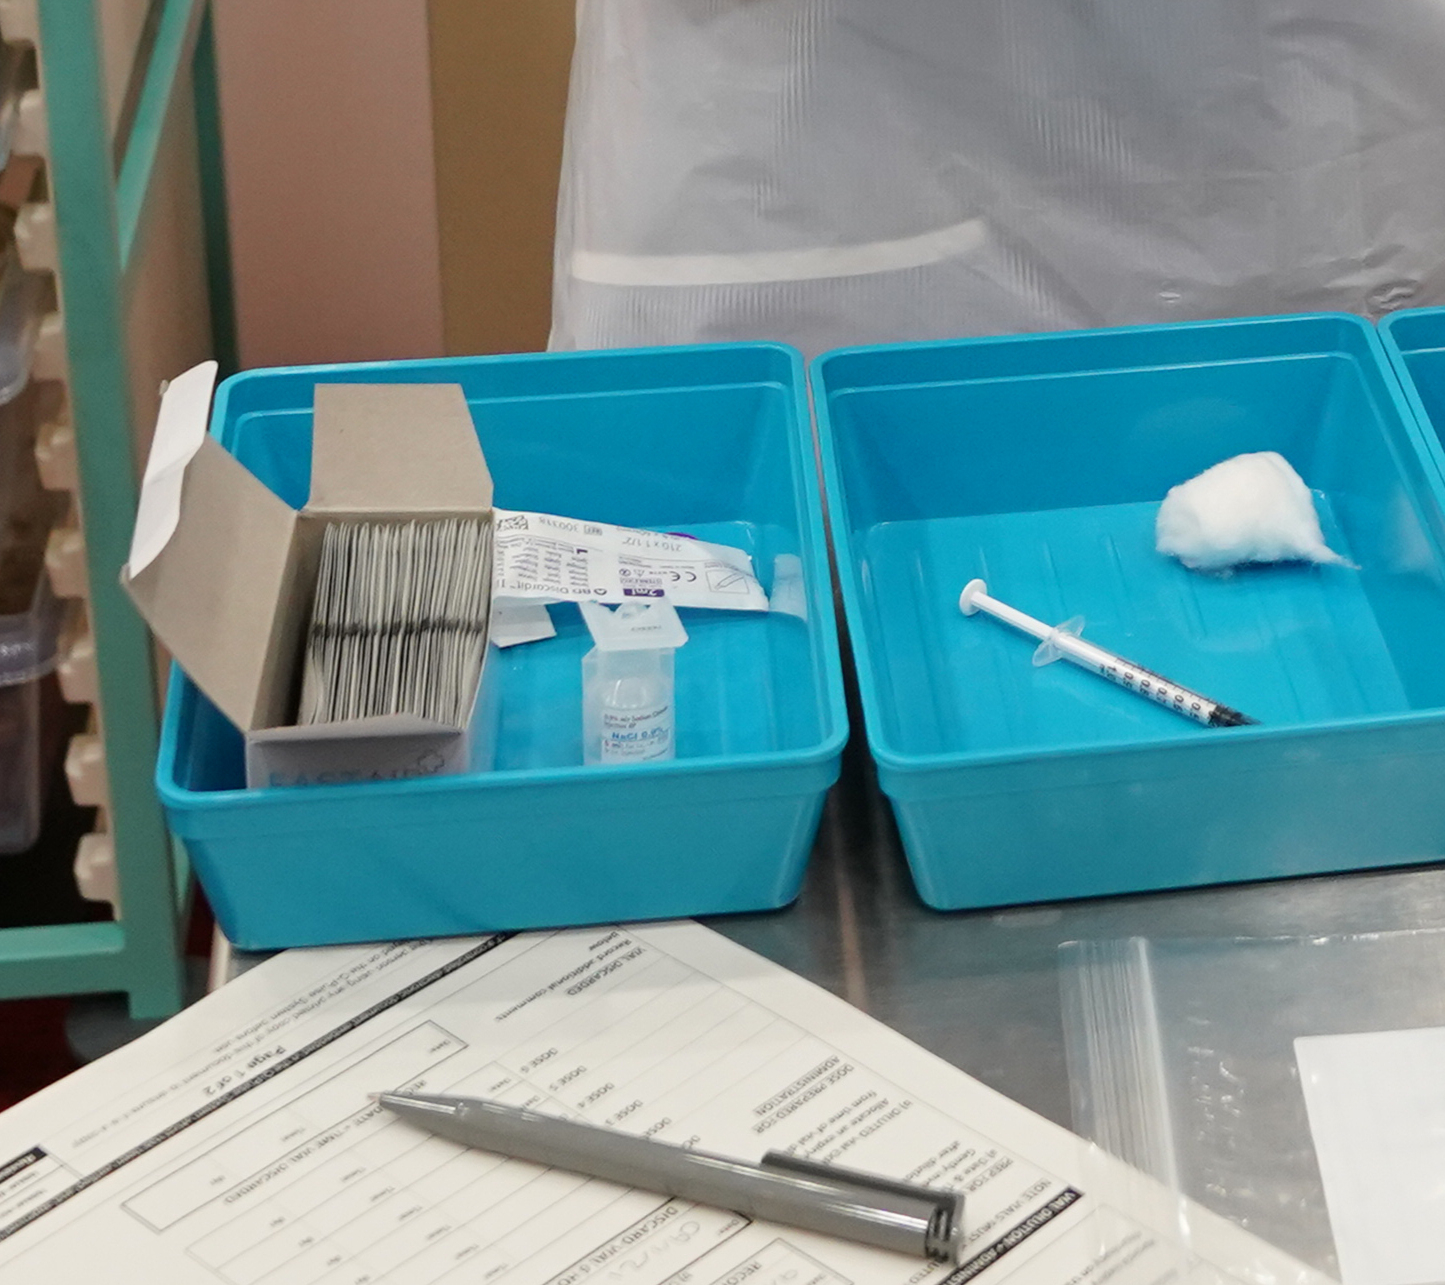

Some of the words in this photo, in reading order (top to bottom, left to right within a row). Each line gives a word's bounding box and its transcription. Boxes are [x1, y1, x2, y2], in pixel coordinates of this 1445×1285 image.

[631, 587, 659, 597] 2ml
[564, 960, 621, 996] DISCARDED
[243, 1043, 286, 1069] Page
[201, 1086, 215, 1096] 2
[753, 1055, 840, 1115] ADMINISTRATION
[1047, 1191, 1075, 1211] VIAL
[1004, 1208, 1052, 1242] DILUTION
